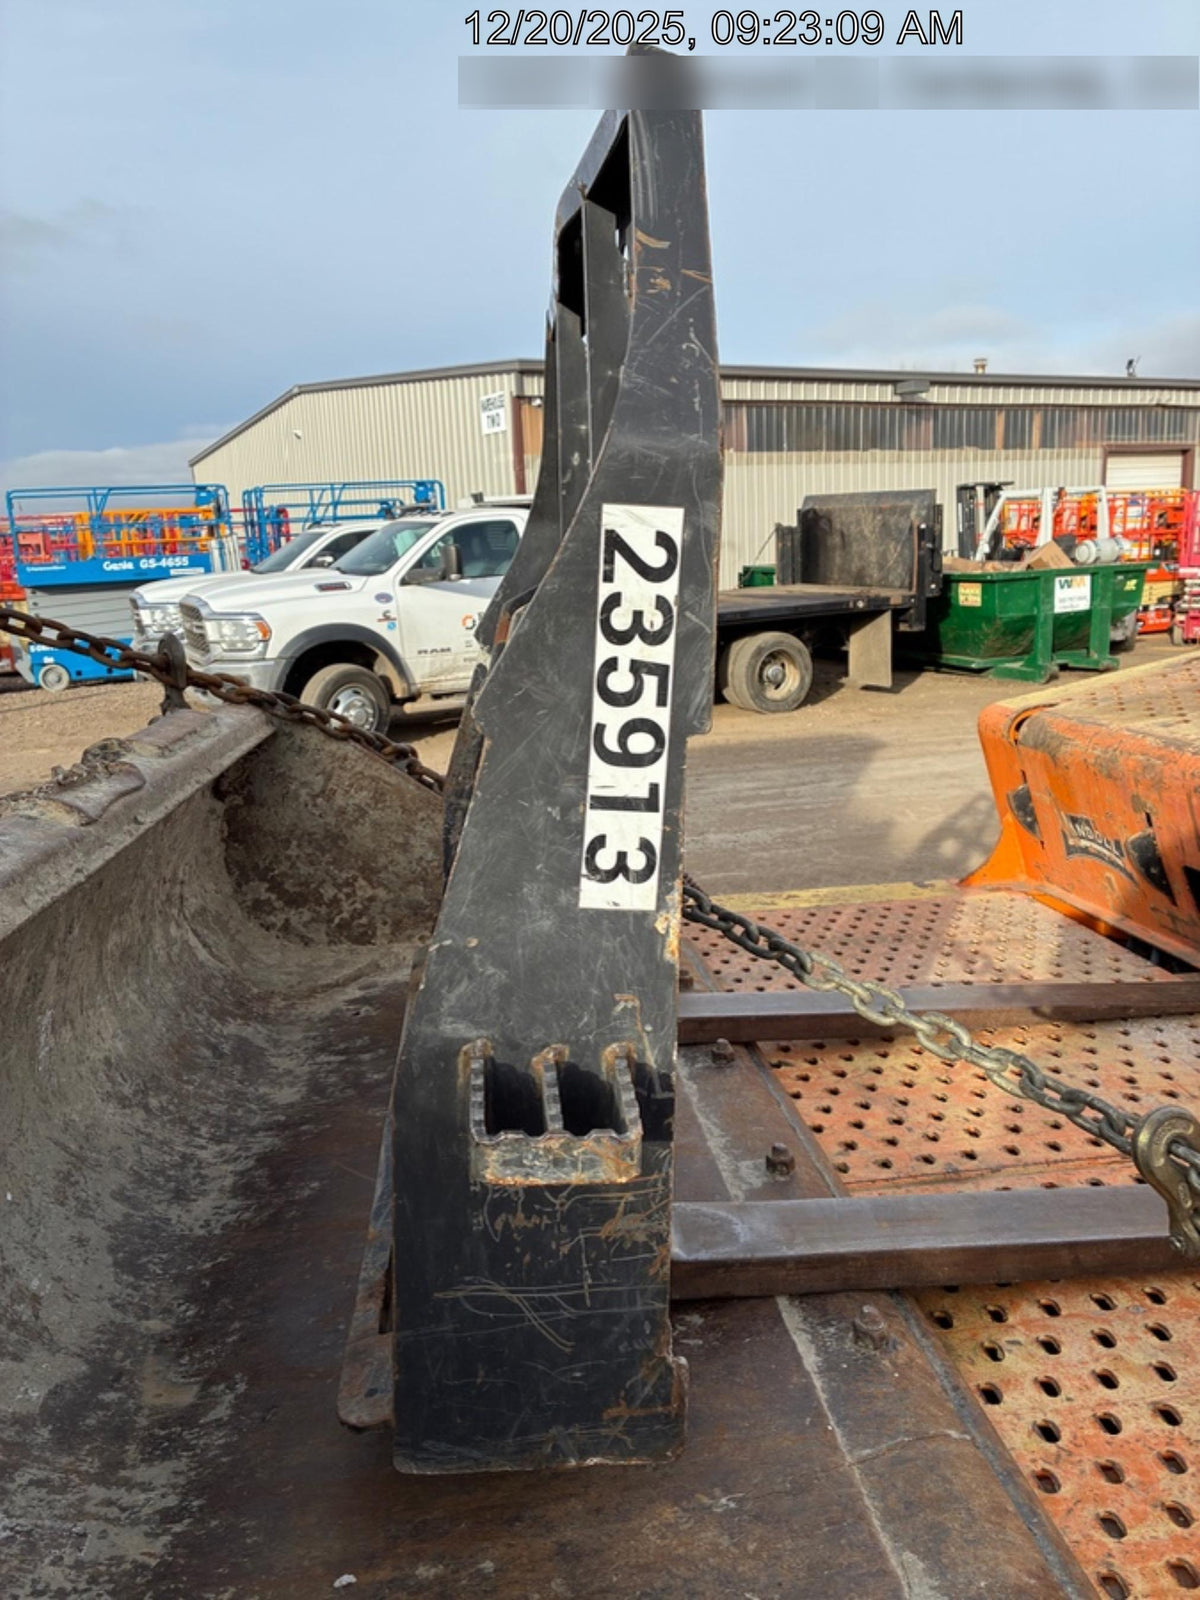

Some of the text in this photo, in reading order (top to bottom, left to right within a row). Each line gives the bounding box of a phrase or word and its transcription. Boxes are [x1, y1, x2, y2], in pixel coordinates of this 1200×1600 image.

[102, 556, 189, 571] Genie GS-4655
[1058, 576, 1086, 589] WM
[584, 528, 679, 885] 235913
